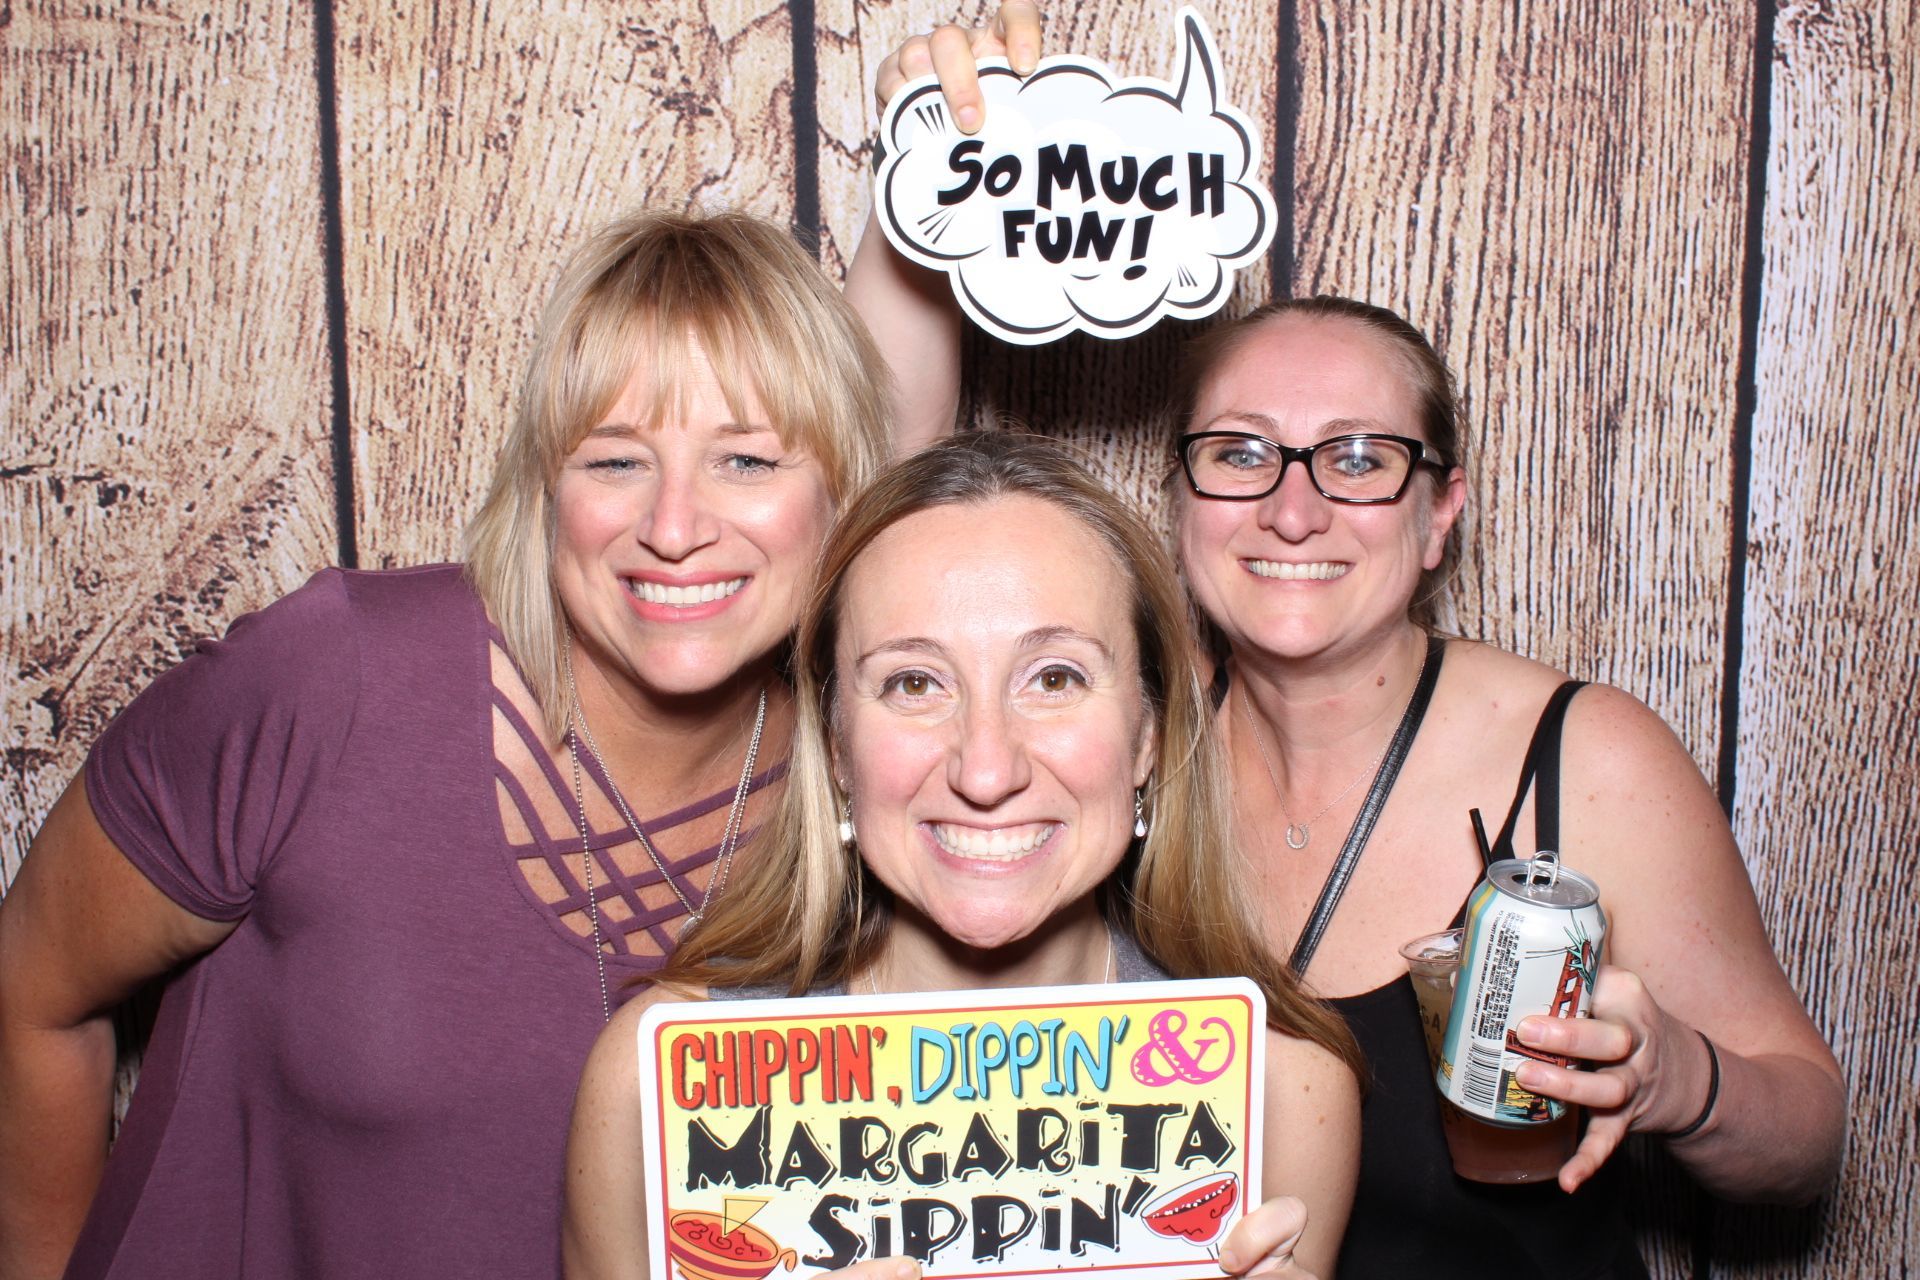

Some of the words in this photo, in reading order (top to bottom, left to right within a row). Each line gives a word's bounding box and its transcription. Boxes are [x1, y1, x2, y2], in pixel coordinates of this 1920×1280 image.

[937, 140, 1022, 206] SO
[1037, 143, 1225, 218] MUCH
[1002, 208, 1155, 281] FUN!
[910, 1014, 1129, 1103] DIPPIN'
[1129, 1008, 1236, 1087] &
